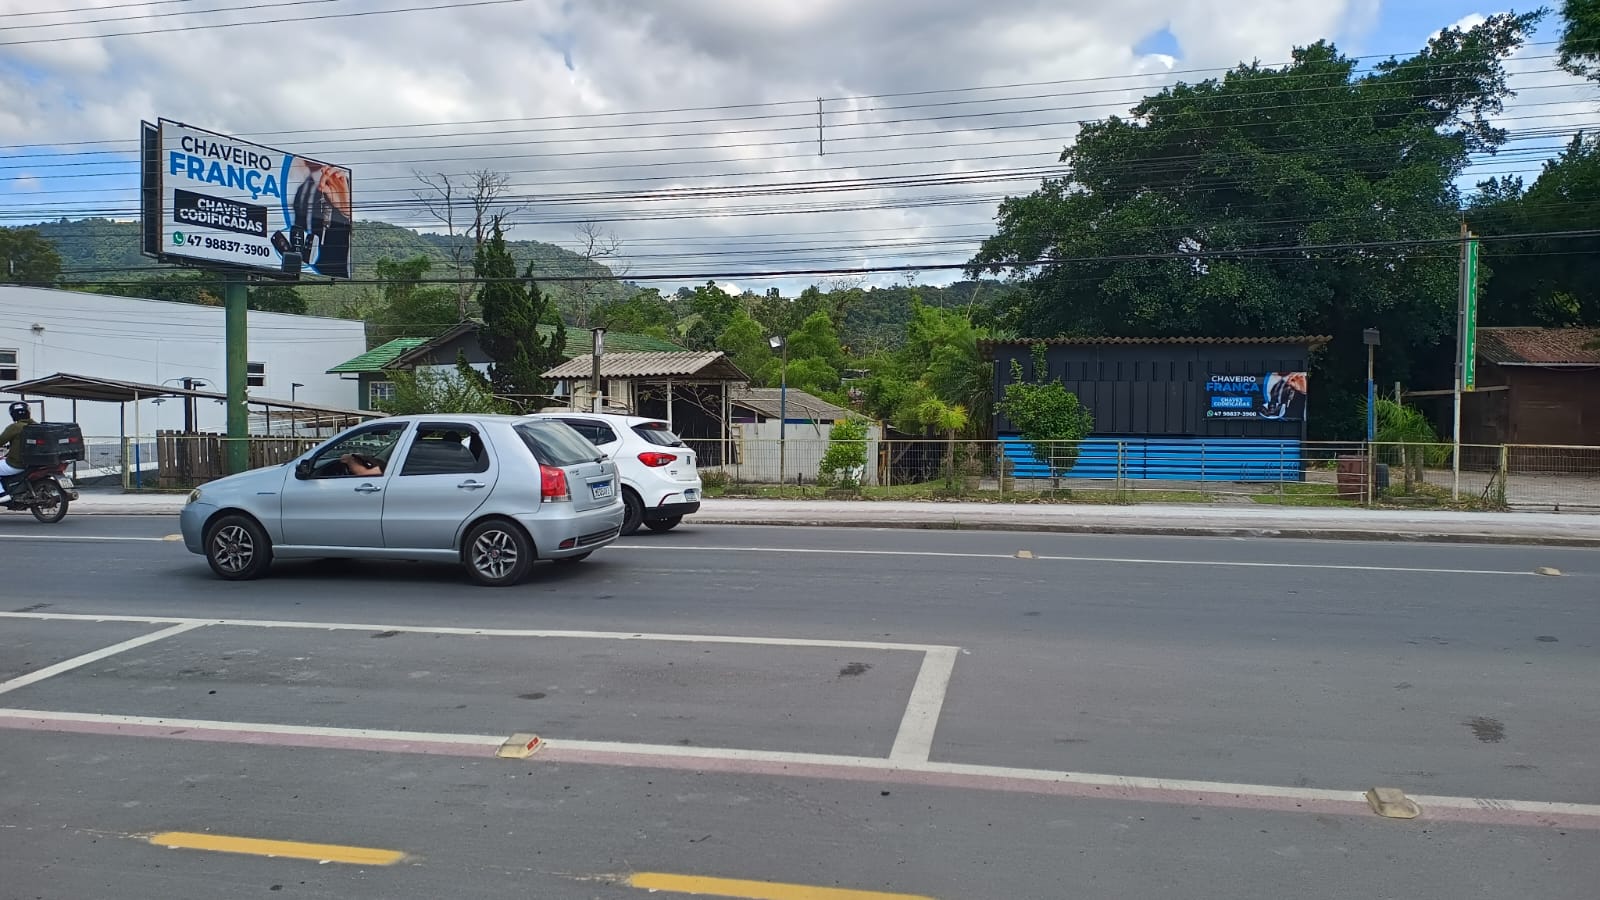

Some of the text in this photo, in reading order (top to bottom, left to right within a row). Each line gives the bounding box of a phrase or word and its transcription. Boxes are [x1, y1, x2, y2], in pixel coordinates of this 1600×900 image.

[181, 136, 271, 171] CHAVEIRO
[170, 151, 280, 200] FRANÇA
[197, 198, 247, 218] CHAVES
[179, 208, 263, 233] CODIFICADAS
[187, 234, 270, 257] 47 98837-3900
[1206, 382, 1260, 394] FRANÇA
[1211, 375, 1256, 383] CHAVEIRO
